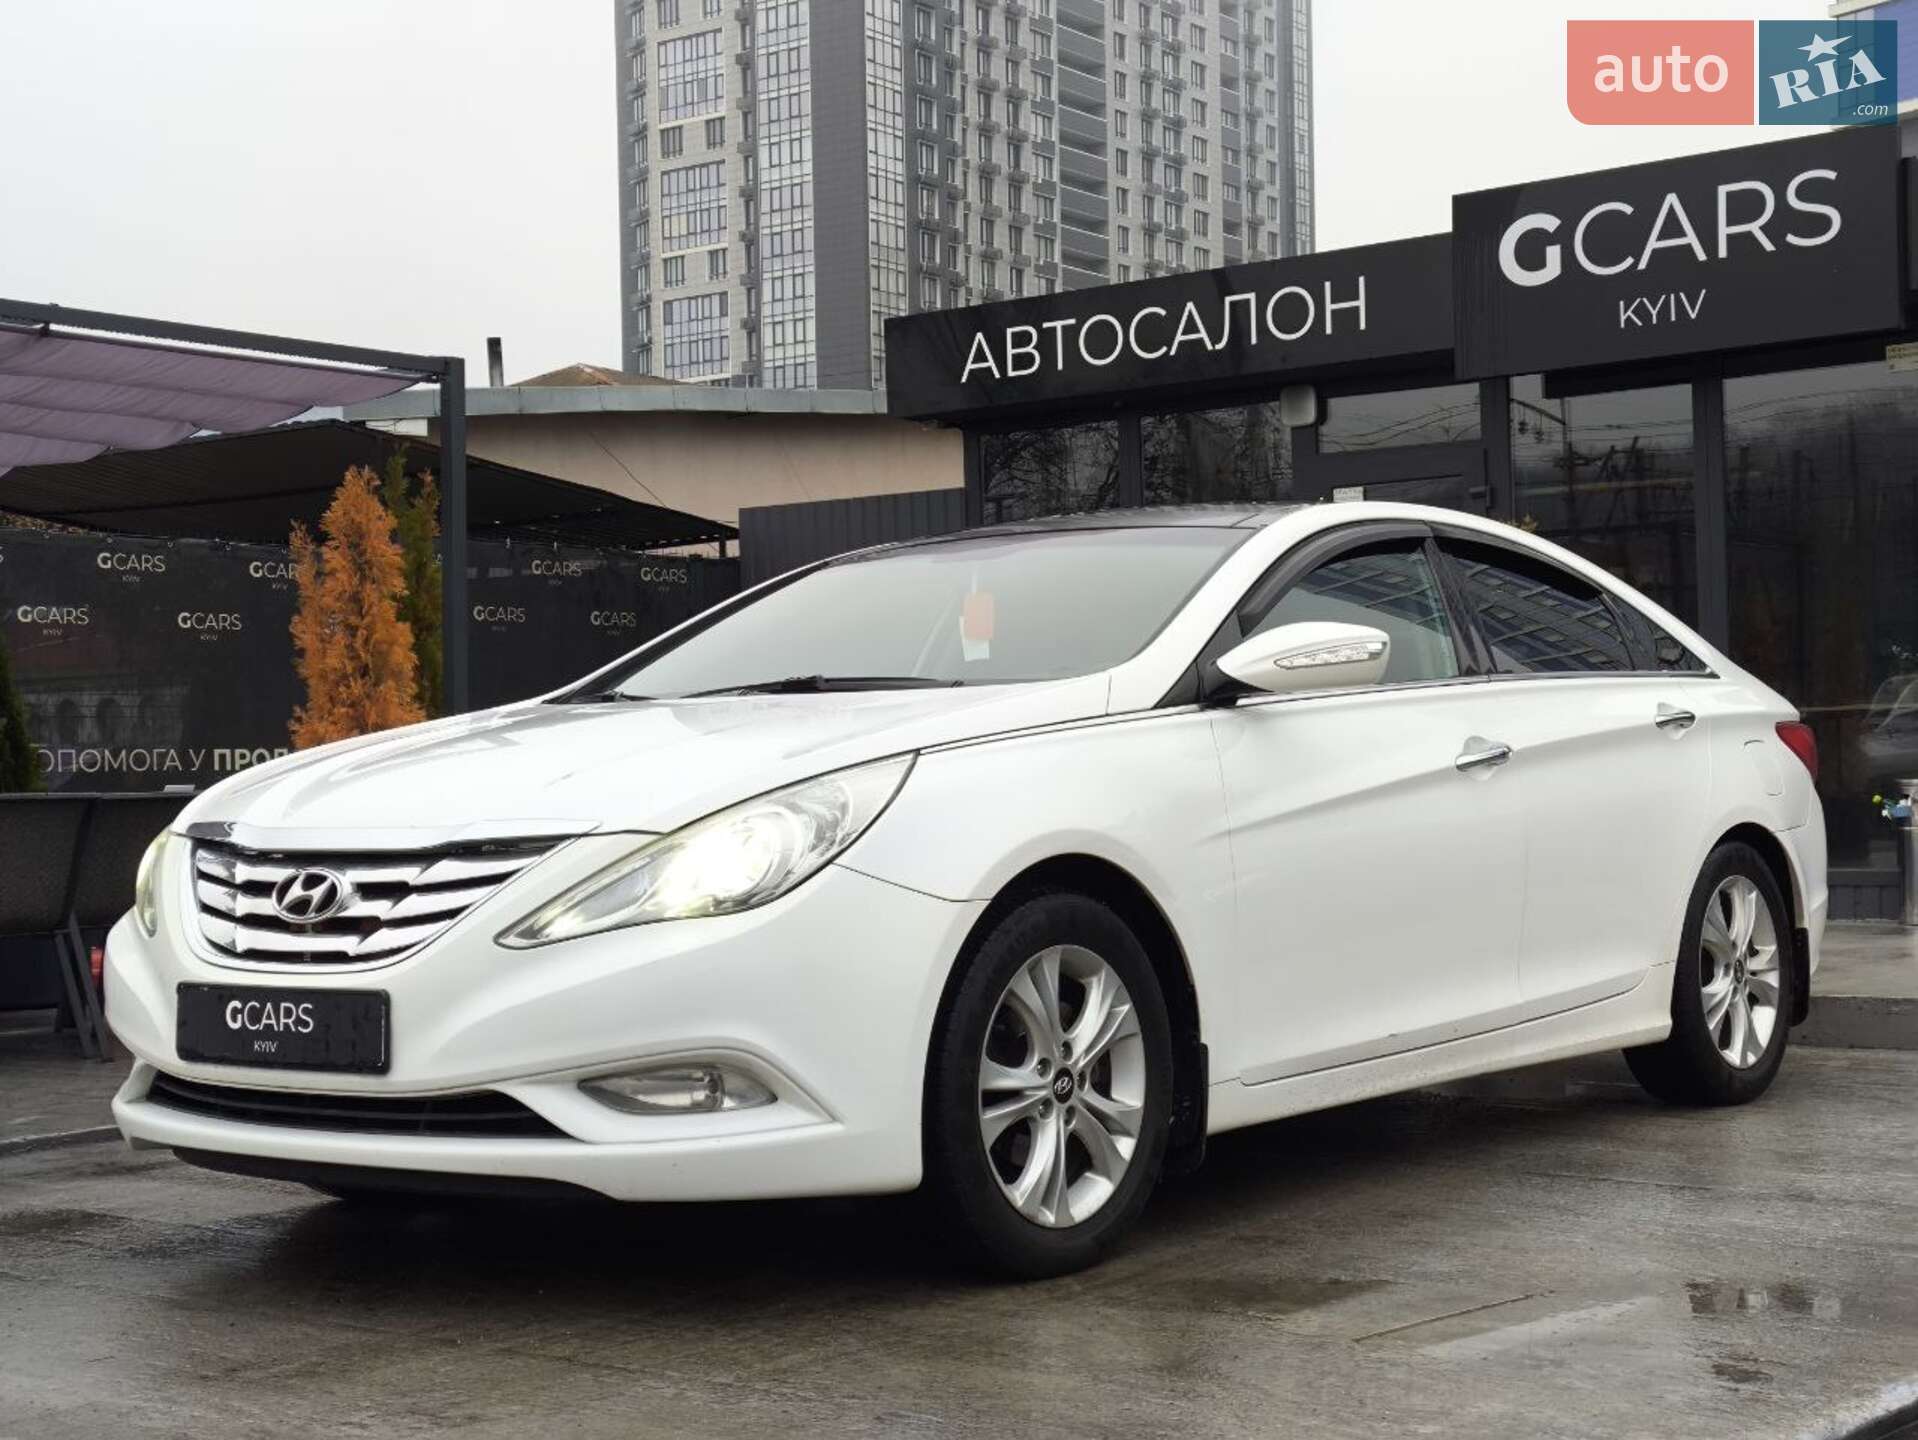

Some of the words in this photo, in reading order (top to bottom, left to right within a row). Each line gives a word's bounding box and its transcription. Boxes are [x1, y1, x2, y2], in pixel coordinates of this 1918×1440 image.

[1498, 168, 1842, 288] GCARS
[1619, 289, 1706, 329] KYIV
[961, 275, 1367, 383] АВТОСАЛОН
[97, 552, 166, 572] GCARS
[532, 559, 583, 577] GCARS
[640, 567, 688, 584] GCARS
[17, 605, 89, 625] GCARS
[178, 612, 242, 630] GCARS
[473, 605, 526, 623] GCARS
[590, 610, 636, 627] GCARS
[188, 748, 207, 772] У
[225, 1000, 314, 1033] GCARS
[253, 1040, 277, 1053] KYIV
